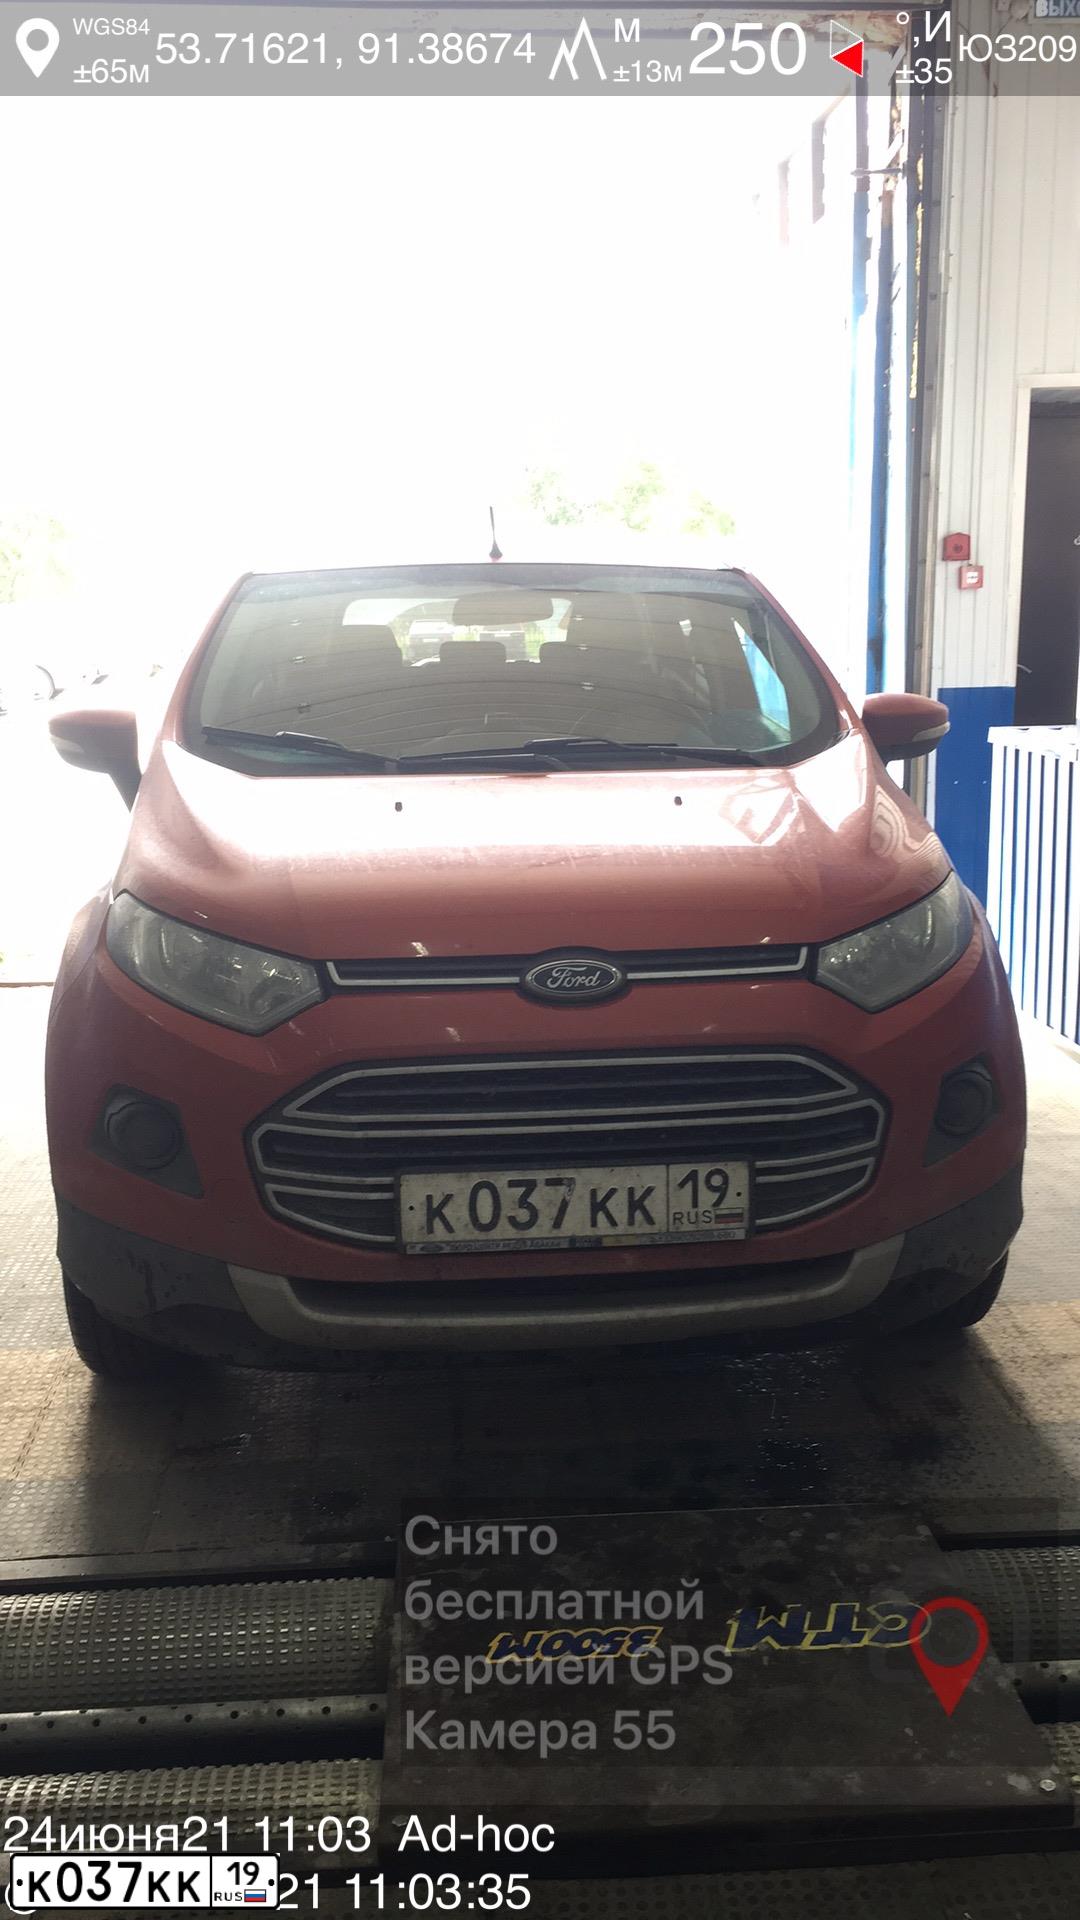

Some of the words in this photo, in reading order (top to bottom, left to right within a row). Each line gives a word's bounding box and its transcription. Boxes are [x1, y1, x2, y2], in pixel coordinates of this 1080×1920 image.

[547, 966, 601, 988] Ford
[676, 1168, 730, 1209] 19
[672, 1208, 714, 1226] RUS
